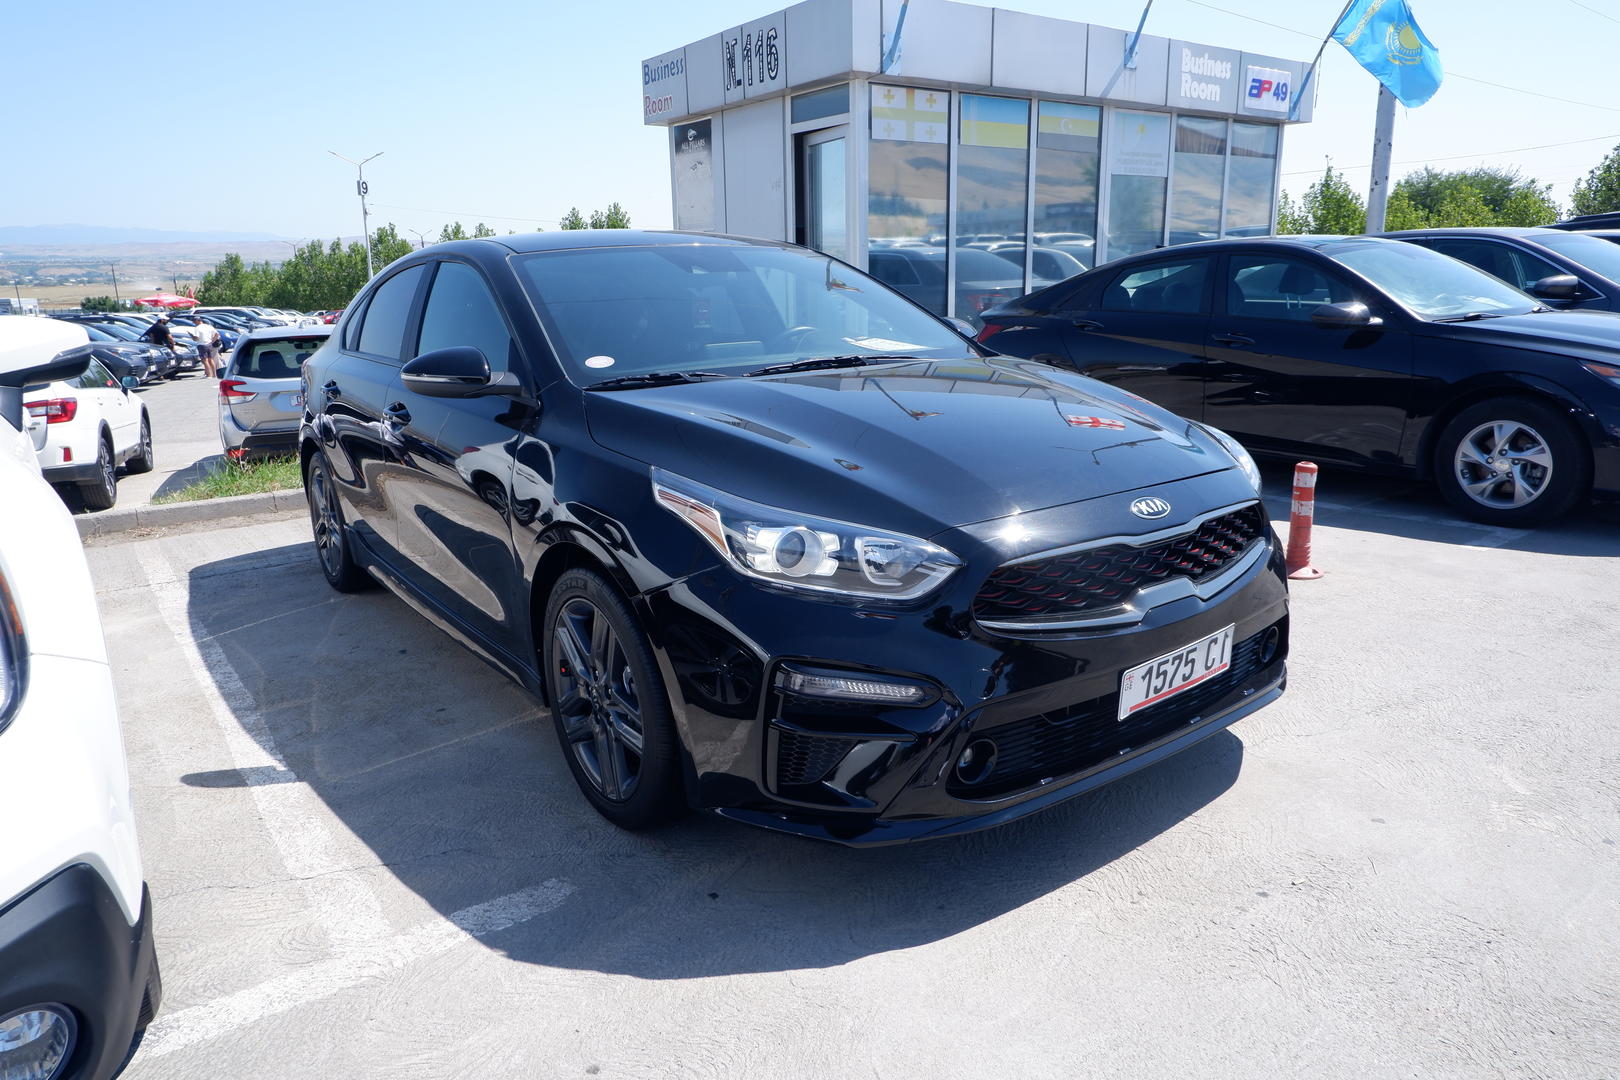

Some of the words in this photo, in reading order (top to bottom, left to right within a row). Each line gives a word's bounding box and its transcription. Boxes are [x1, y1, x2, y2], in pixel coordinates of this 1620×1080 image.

[644, 57, 684, 86] Business
[1181, 47, 1232, 79] Business
[1180, 73, 1221, 102] Room
[1273, 81, 1288, 102] 49
[645, 95, 673, 117] Room
[361, 181, 368, 195] 9
[1135, 497, 1167, 515] KIA
[1141, 647, 1197, 699] 1575
